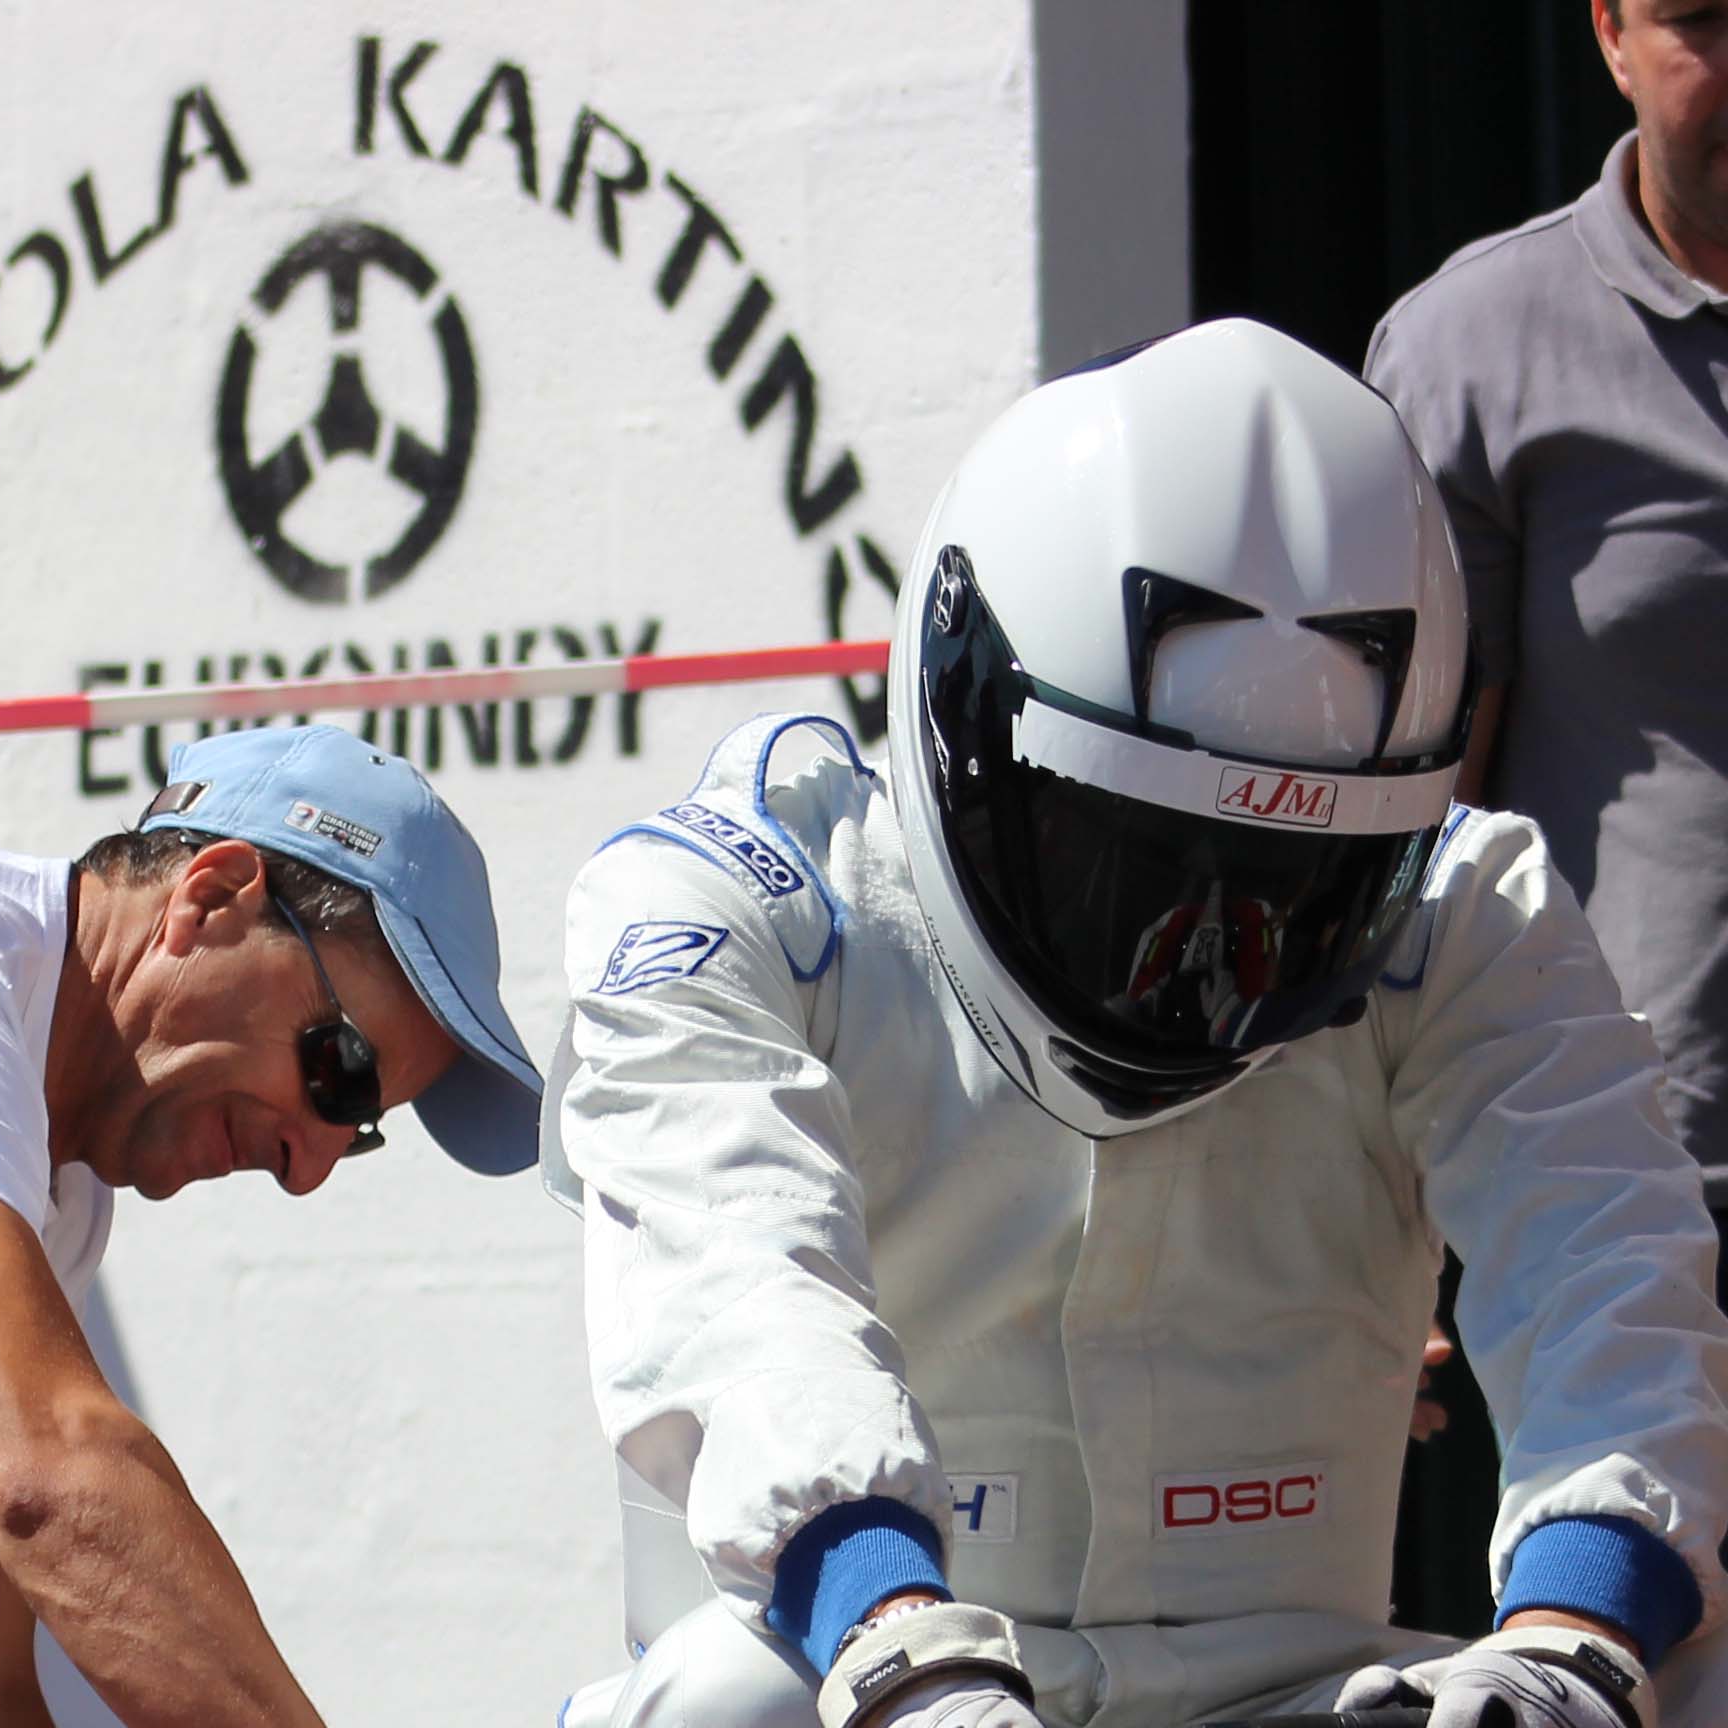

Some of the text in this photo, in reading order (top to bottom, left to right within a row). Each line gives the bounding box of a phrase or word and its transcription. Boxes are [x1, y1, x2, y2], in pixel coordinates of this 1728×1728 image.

[1220, 772, 1327, 816] AJM
[322, 814, 379, 843] CHALLENGE
[672, 803, 795, 890] sparco
[604, 928, 646, 987] LEVEL
[1163, 1474, 1316, 1529] DSC
